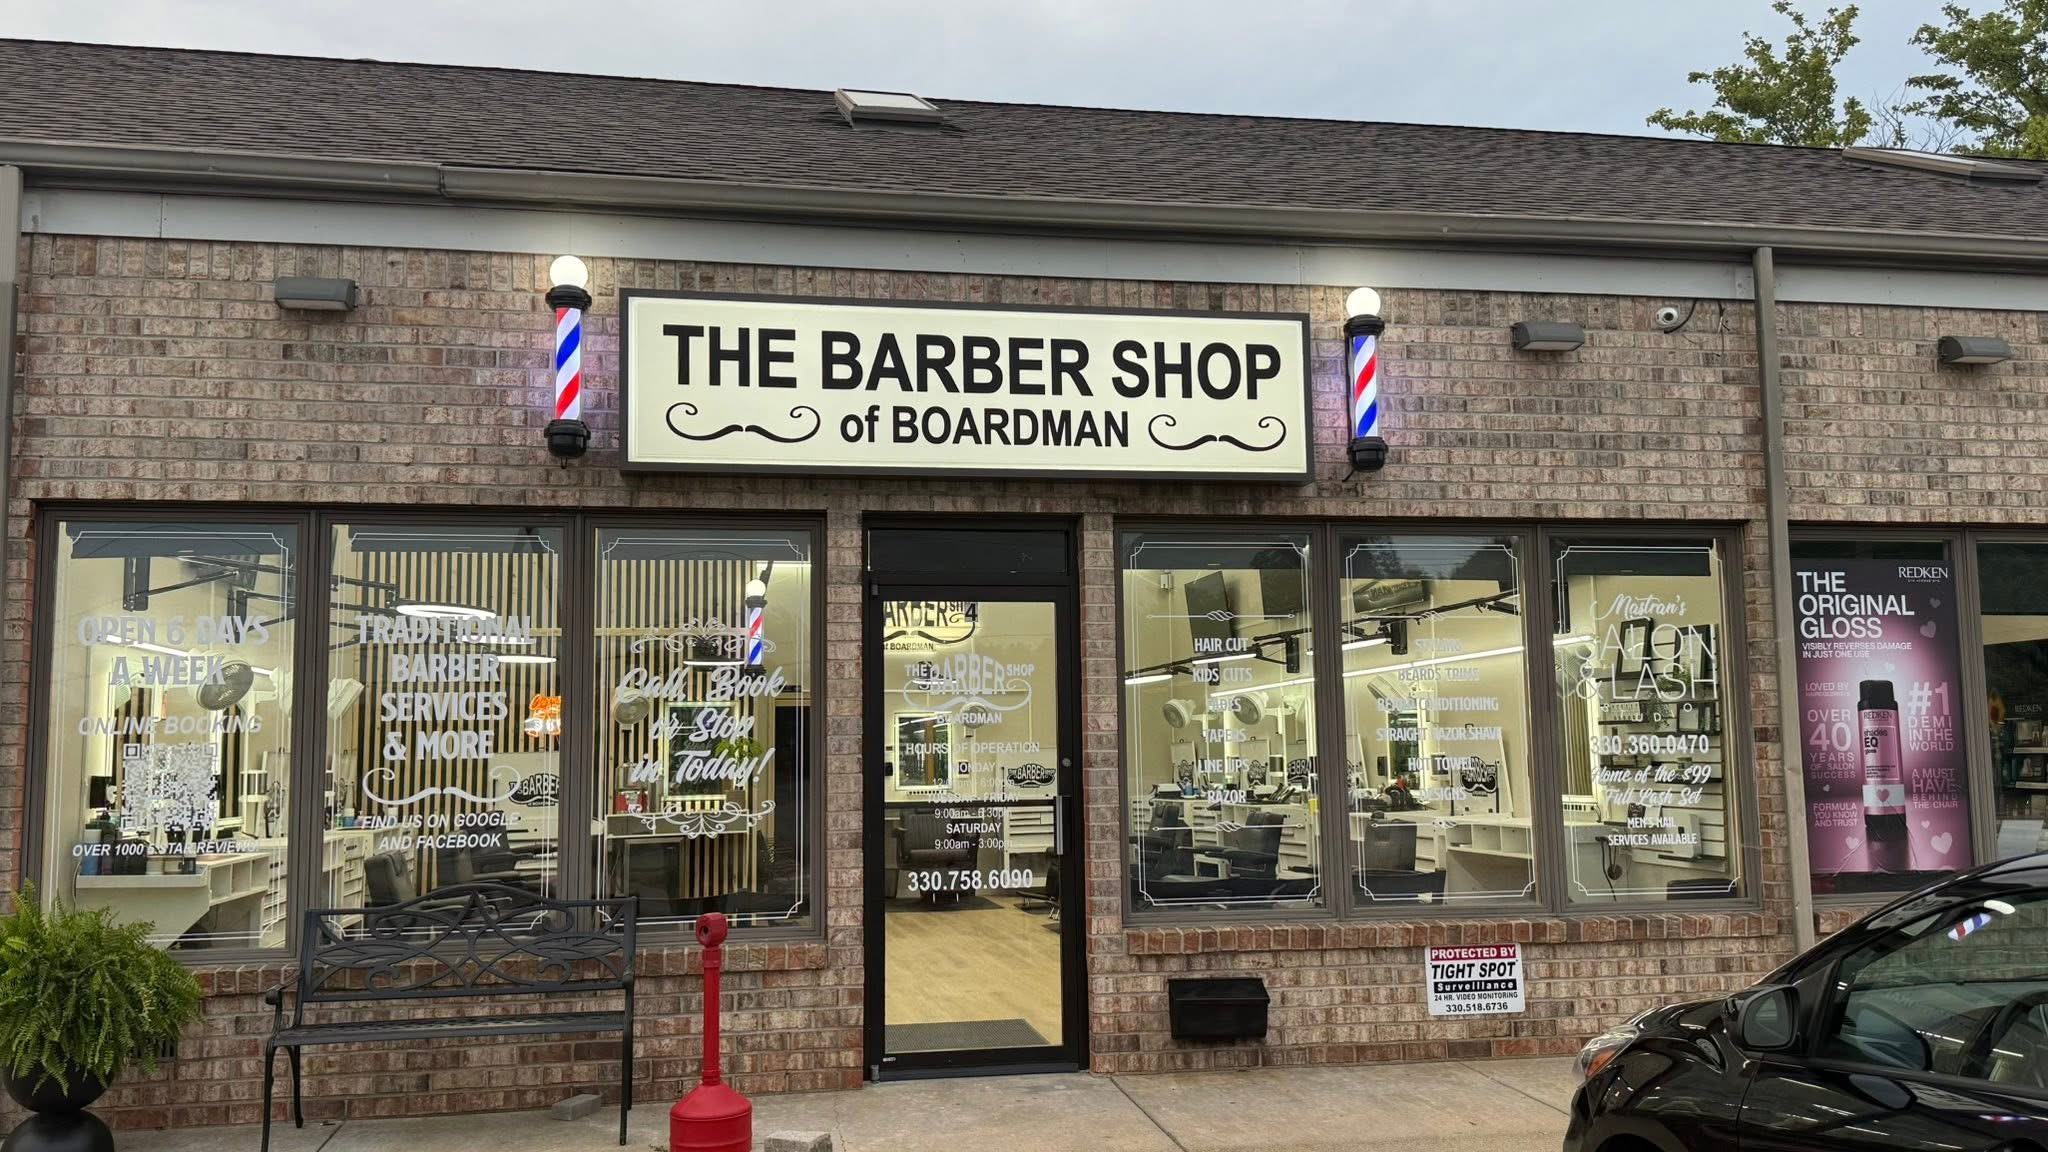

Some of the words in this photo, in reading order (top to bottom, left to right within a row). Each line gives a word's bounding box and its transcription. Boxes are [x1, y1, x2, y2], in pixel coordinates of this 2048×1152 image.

[663, 325, 796, 388] THE
[822, 331, 1093, 397] BARBER
[1112, 340, 1281, 400] SHOP
[840, 404, 881, 443] of
[893, 406, 1128, 447] BOARDMAN
[1898, 567, 1948, 579] REDKEN
[1797, 571, 1846, 592] THE
[965, 603, 978, 621] 4
[1590, 594, 1687, 621] Mastran's
[1799, 594, 1915, 616] ORIGINAL
[884, 601, 948, 627] ARBER
[78, 616, 156, 646] OPEN
[166, 616, 185, 645] 6
[196, 615, 270, 646] DAYS
[355, 615, 537, 644] TRADITIONAL
[1800, 617, 1883, 639] GLOSS
[890, 642, 934, 651] BOARDMAN
[1194, 638, 1222, 652] HAIR
[1225, 638, 1249, 651] CUT
[1802, 642, 1832, 650] VISIBLY
[1833, 642, 1875, 650] REVERSES
[1876, 642, 1912, 650] DAMAGE
[1803, 651, 1811, 659] IN
[1812, 651, 1833, 659] JUST
[111, 656, 132, 685] A
[143, 655, 226, 686] WEEK
[391, 653, 501, 682] BARBER
[904, 664, 928, 677] THE
[929, 653, 1007, 695] BARBER
[1006, 664, 1035, 677] SHOP
[1399, 668, 1442, 681] BEARDS
[1193, 669, 1219, 682] KIDS
[1222, 668, 1253, 682] CUTS
[1612, 662, 1718, 700] LASH
[706, 665, 788, 701] Book
[1805, 682, 1834, 691] LOVED
[1837, 682, 1849, 691] BY
[1907, 681, 1952, 716] #1
[381, 691, 508, 722] SERVICES
[937, 712, 1002, 725] BOARDMAN
[1807, 709, 1851, 722] OVER
[1863, 711, 1892, 720] REDKEN
[1908, 715, 1952, 729] DEMI
[79, 717, 158, 736] ONLINE
[165, 715, 263, 736] BOOKING
[650, 712, 683, 739] or
[688, 707, 755, 747] Stop
[1203, 729, 1247, 743] TAPERS
[1376, 728, 1427, 741] STRAIGHT
[1809, 722, 1852, 752] 40
[1864, 729, 1888, 737] shades
[1908, 729, 1924, 741] IN
[1925, 728, 1953, 741] THE
[383, 731, 407, 760] &
[417, 730, 496, 760] MORE
[905, 742, 949, 756] HOURS
[954, 742, 969, 754] OF
[971, 741, 1041, 755] OPERATION
[1591, 734, 1709, 755] 330.360.0470
[1864, 737, 1879, 748] EQ
[1909, 741, 1954, 752] WORLD
[1408, 757, 1431, 771] HOT
[1434, 757, 1474, 771] TOWEL
[1810, 752, 1855, 763] YEARS
[629, 753, 663, 783] in
[674, 747, 776, 786] Today!
[1017, 764, 1045, 780] BARBER
[1199, 760, 1223, 773] LINE
[1226, 759, 1250, 773] UPS
[1810, 763, 1822, 771] OF
[1827, 762, 1855, 770] SALON
[1592, 766, 1633, 784] Home
[1635, 765, 1652, 782] of
[1655, 765, 1677, 782] the
[1682, 764, 1712, 784] $99
[1811, 771, 1856, 779] SUCCESS
[1911, 768, 1920, 779] A
[1922, 768, 1954, 779] MUST
[1912, 778, 1955, 793] HAVE
[984, 791, 1019, 803] FRIDAY
[1207, 790, 1247, 804] RAZOR
[1606, 787, 1635, 805] Full
[1636, 788, 1674, 807] Lash
[1679, 787, 1703, 805] Set
[1912, 793, 1958, 801] BEHIND
[1813, 802, 1857, 811] FORMULA
[1914, 801, 1930, 809] THE
[1933, 801, 1958, 809] CHAIR
[935, 807, 968, 819] 9:00am
[1814, 811, 1831, 819] YOU
[1832, 811, 1857, 819] KNOW
[361, 814, 399, 830] FIND
[402, 813, 424, 829] US
[427, 813, 451, 828] ON
[453, 812, 520, 828] GOOGLE
[1657, 817, 1676, 828] NAIL
[1814, 819, 1833, 827] AND
[1834, 819, 1857, 827] TRUST
[946, 822, 1002, 835] SATURDAY
[379, 835, 412, 850] AND
[416, 832, 503, 849] FACEBOOK
[935, 838, 970, 850] 9:00am
[1608, 834, 1649, 846] SERVICES
[1651, 833, 1698, 846] AVAILABLE
[73, 843, 111, 857] OVER
[114, 843, 144, 857] 1000
[908, 868, 1033, 892] 330.758.6090
[1431, 947, 1497, 959] PROTECTED
[1500, 946, 1515, 957] BY
[1431, 963, 1475, 979] TIGHT
[1478, 961, 1516, 977] SPOT
[1437, 981, 1514, 991] Surveillance
[1456, 993, 1475, 1001] VIDEO
[1477, 991, 1518, 1000] MONITORING
[1446, 1002, 1508, 1013] 330.518.6736
